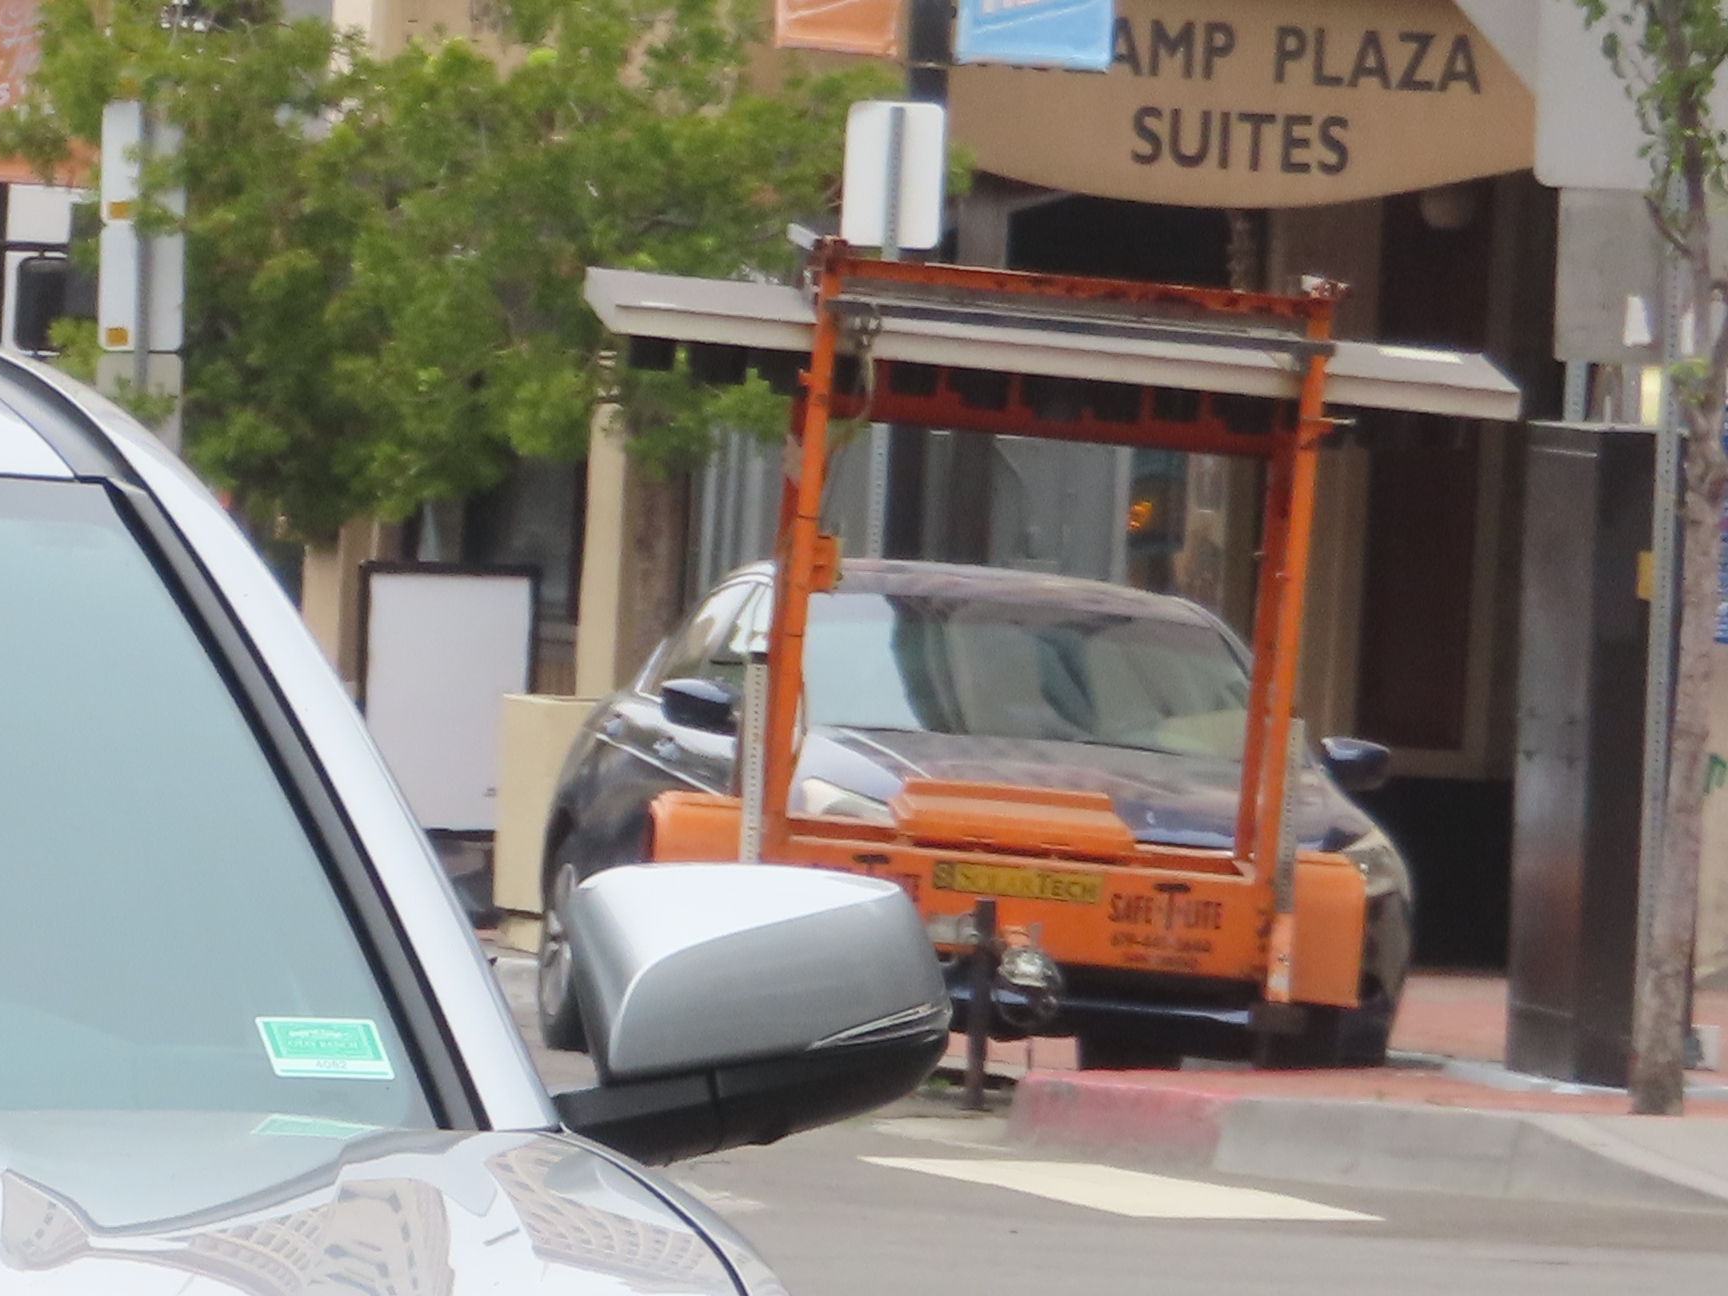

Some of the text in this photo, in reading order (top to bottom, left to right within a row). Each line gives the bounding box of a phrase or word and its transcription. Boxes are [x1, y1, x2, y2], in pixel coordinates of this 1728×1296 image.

[1112, 16, 1482, 95] AMP PLAZA
[1131, 106, 1349, 176] SUITES
